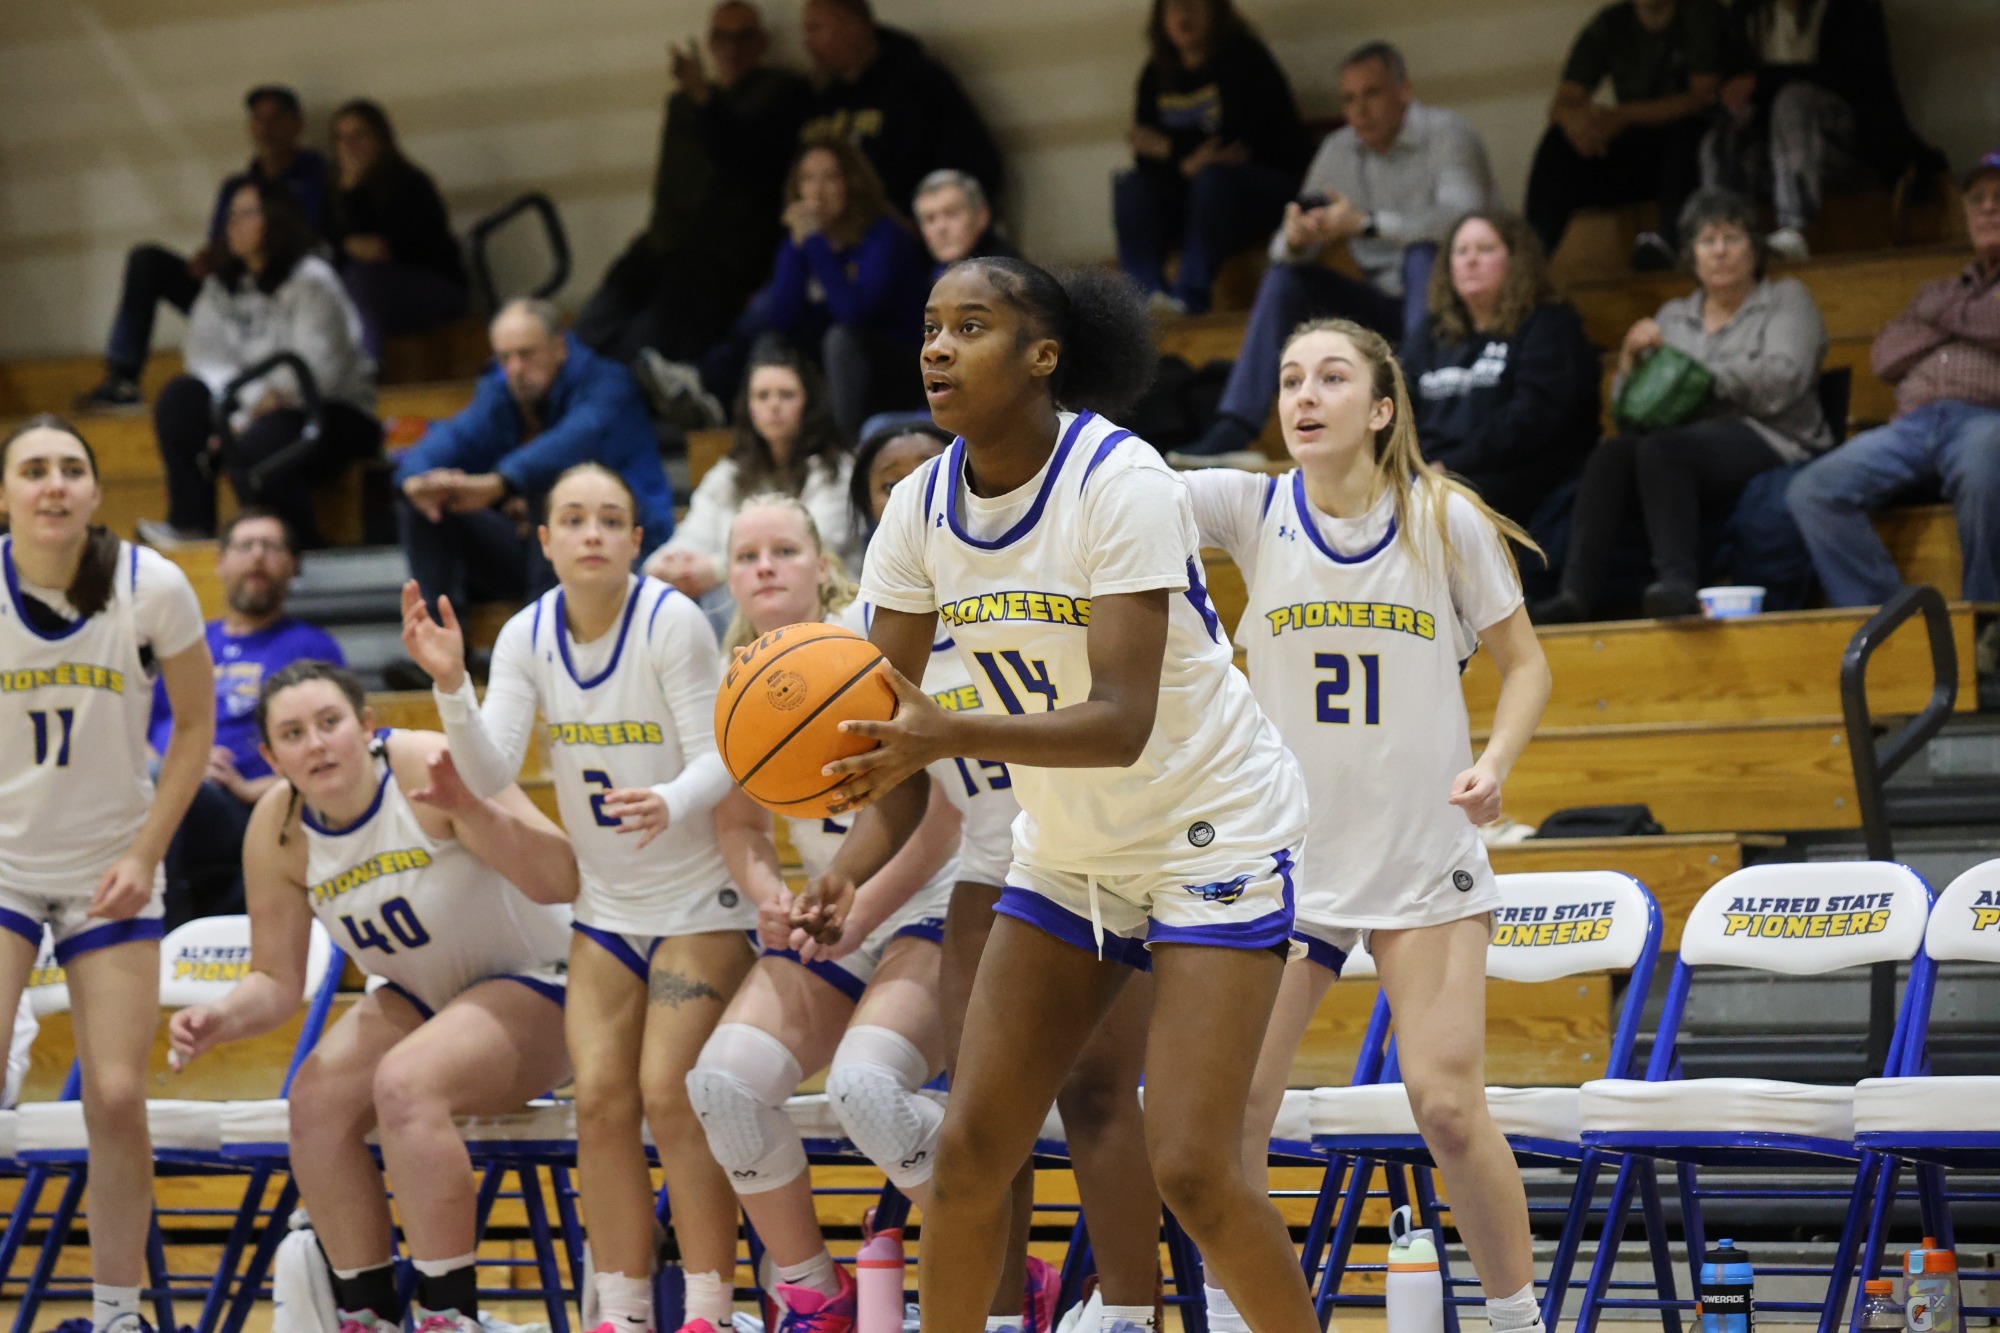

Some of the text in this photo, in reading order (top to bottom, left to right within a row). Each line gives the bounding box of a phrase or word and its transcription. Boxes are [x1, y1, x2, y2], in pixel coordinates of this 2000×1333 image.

[1265, 601, 1436, 641] PIONEERS
[0, 662, 125, 696] IONEERS
[972, 650, 1058, 715] 14
[1314, 652, 1380, 726] 21
[27, 707, 75, 767] 11
[548, 720, 663, 745] PONEERS
[583, 769, 623, 827] 2
[1493, 900, 1615, 922] FRED STATE
[1727, 892, 1895, 913] ALFRED STATE
[339, 896, 431, 955] 40
[1492, 917, 1614, 947] ONEERS
[1723, 909, 1891, 939] PIONEERS
